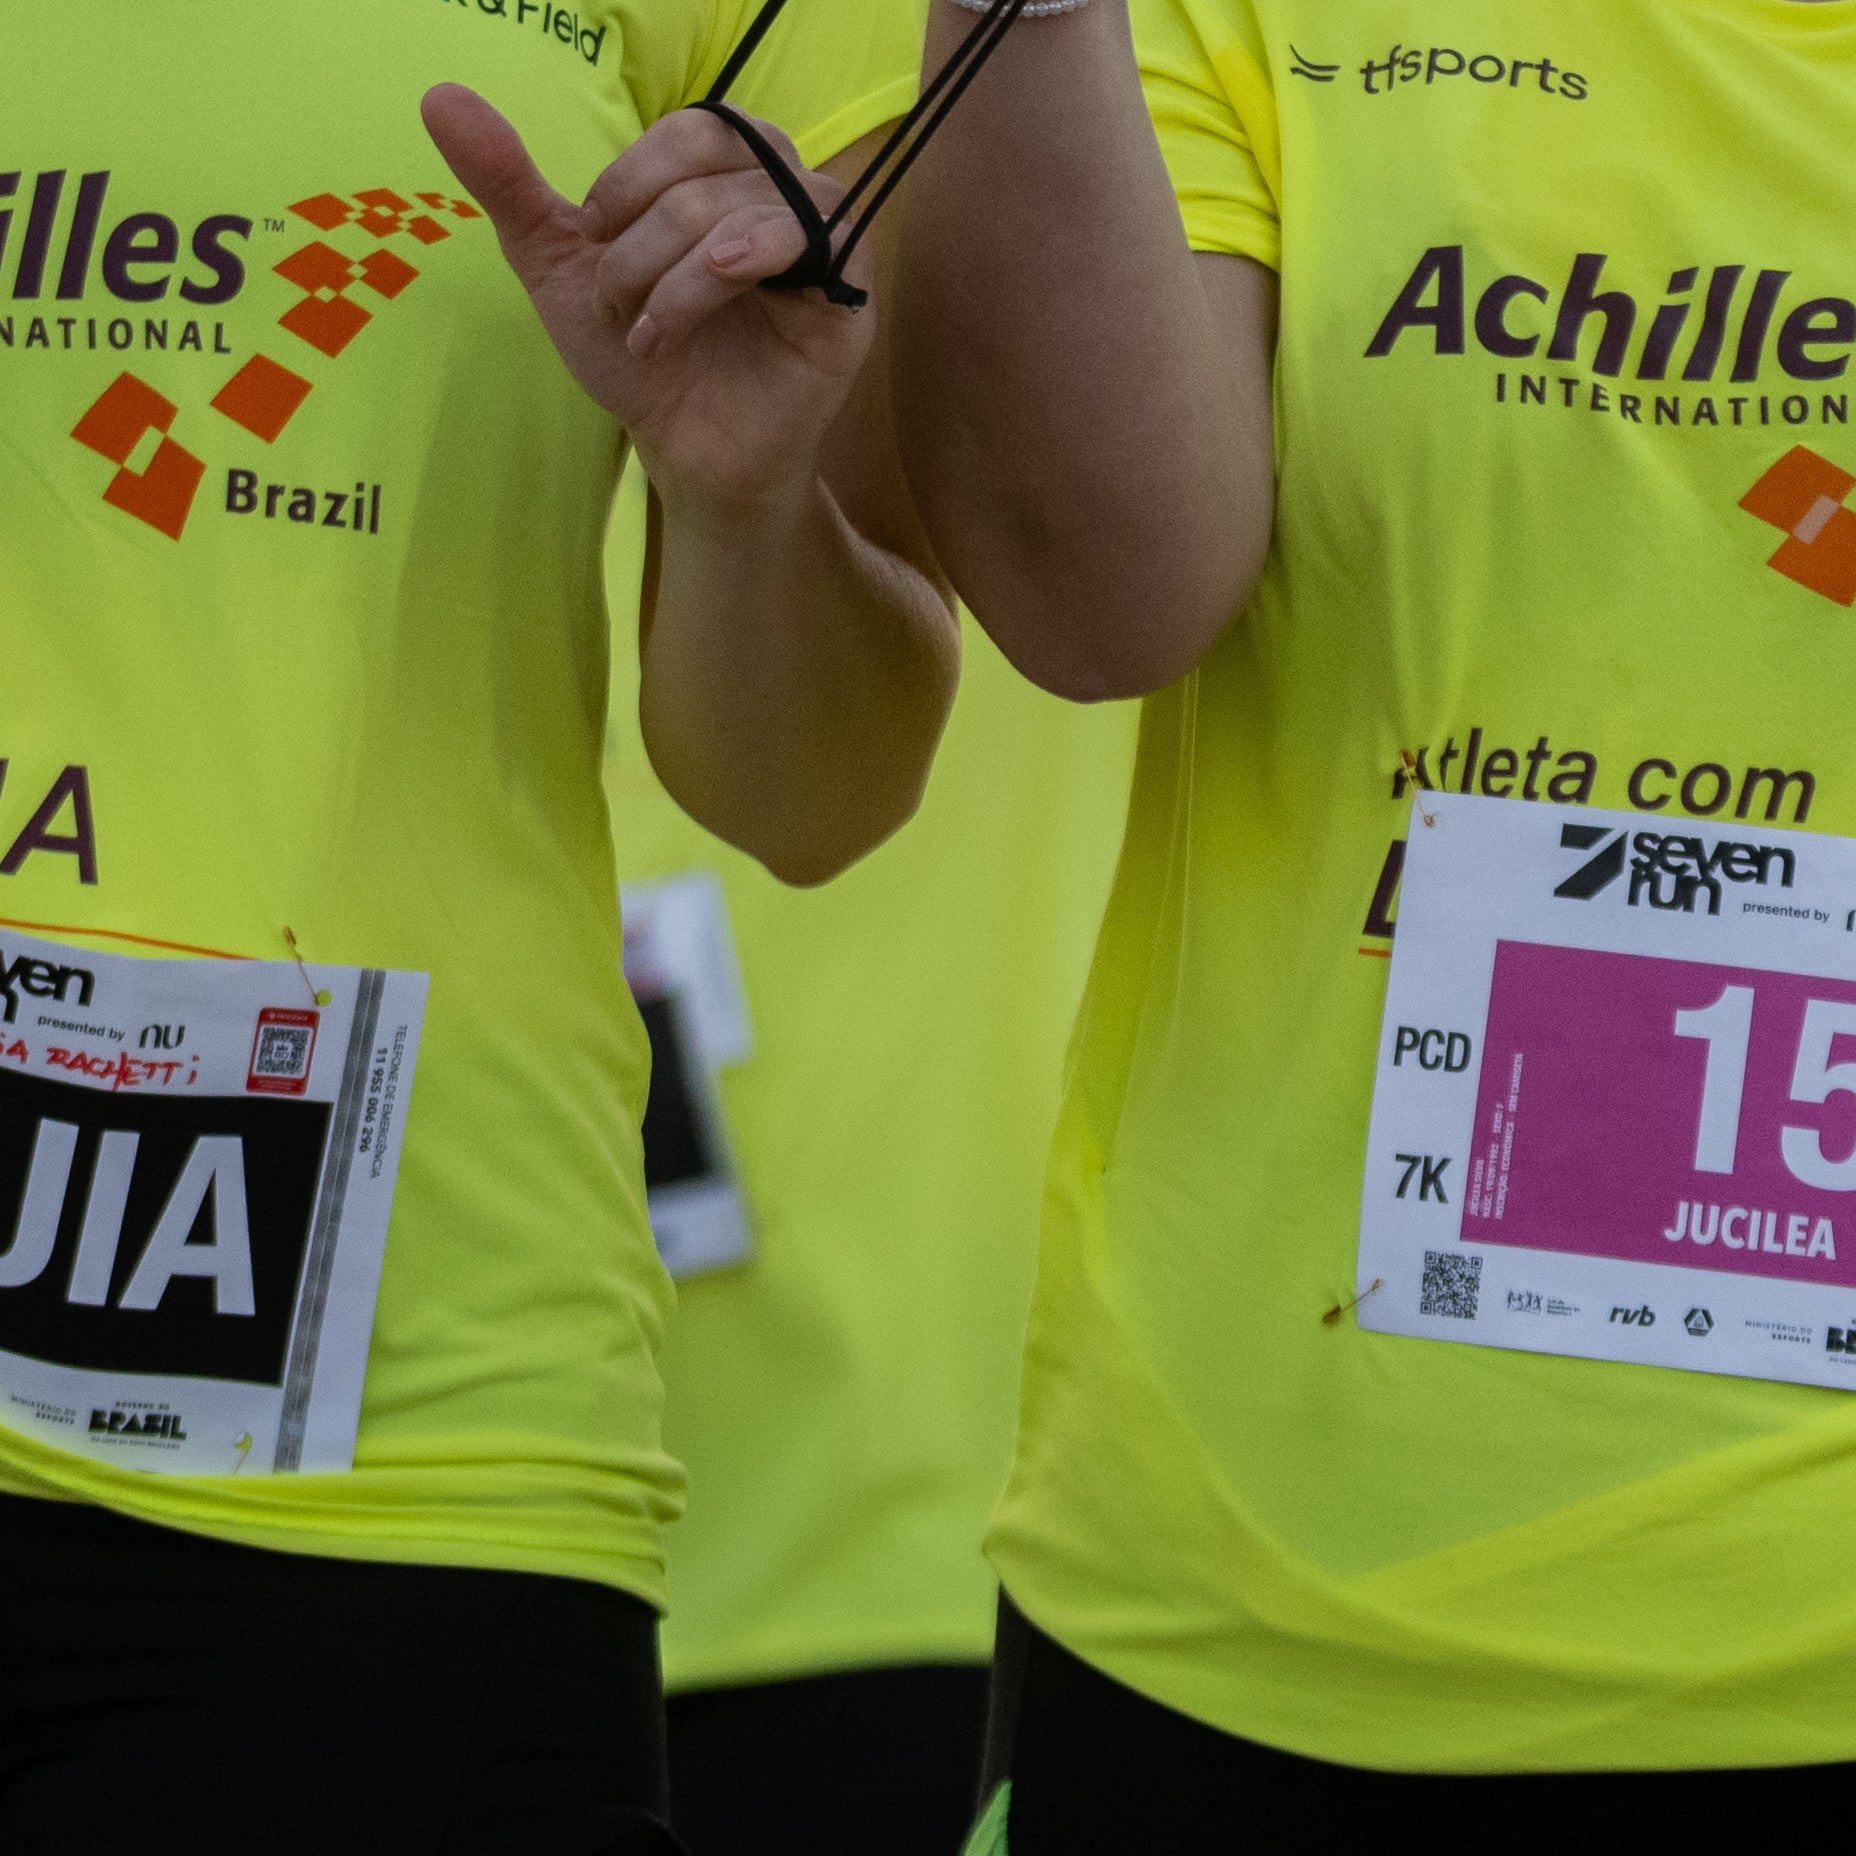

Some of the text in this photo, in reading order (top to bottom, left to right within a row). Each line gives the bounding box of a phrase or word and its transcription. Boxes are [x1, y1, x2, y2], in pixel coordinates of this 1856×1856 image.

[1360, 44, 1588, 101] tfsports
[225, 468, 381, 535] Brazil
[1626, 758, 1816, 824] com
[1629, 830, 1796, 887] seven
[1627, 864, 1724, 916] run
[1743, 902, 1811, 921] presented
[1814, 909, 1830, 924] by
[37, 1015, 106, 1037] presented
[108, 1027, 126, 1043] by
[1394, 1026, 1472, 1073] PCD
[358, 1046, 388, 1153] 11 955 006 296
[384, 1084, 396, 1100] DE
[1396, 1153, 1452, 1204] 7K
[1664, 1201, 1837, 1261] JUCILEA
[1609, 1305, 1656, 1327] rvb
[88, 1408, 187, 1440] BRASIL
